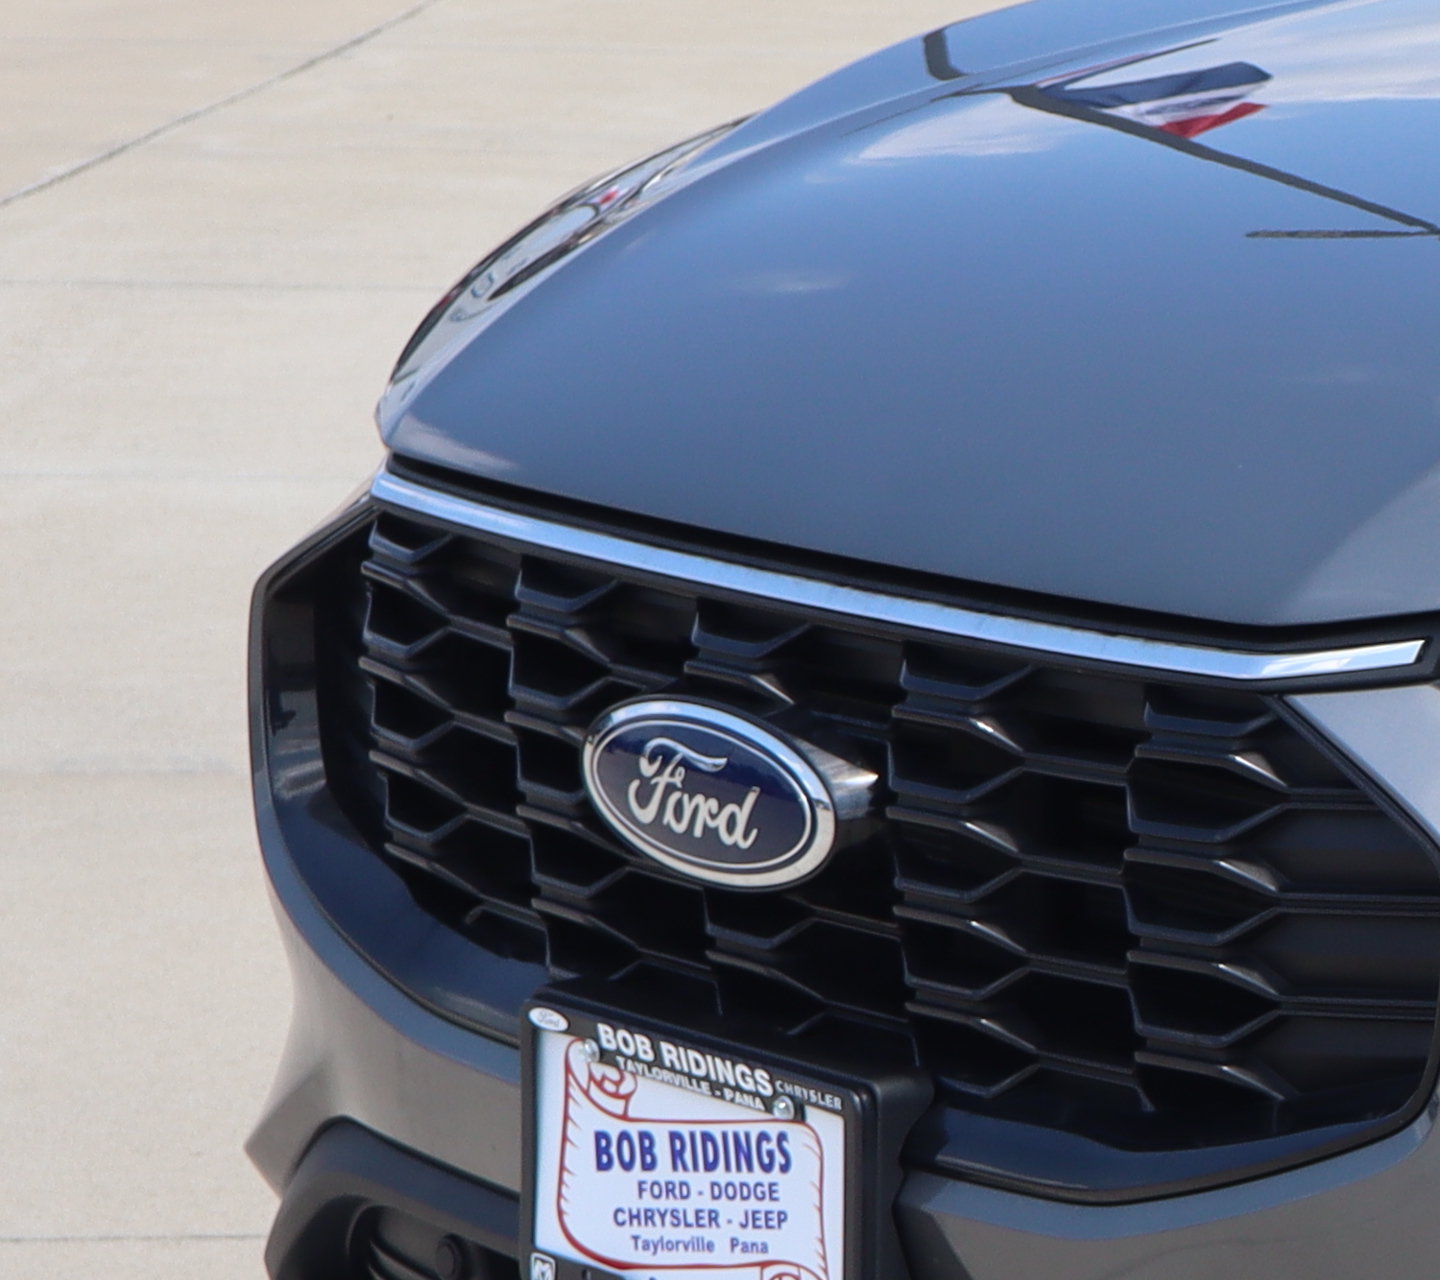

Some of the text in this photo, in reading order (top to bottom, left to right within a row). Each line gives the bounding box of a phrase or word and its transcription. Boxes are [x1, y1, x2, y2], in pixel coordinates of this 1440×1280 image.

[628, 736, 759, 850] Ford
[597, 1022, 774, 1097] BOB RIDINGS
[616, 1055, 711, 1096] TAYLORVILLE
[723, 1088, 766, 1111] PANA
[775, 1079, 842, 1111] CHRYSLER
[594, 1129, 792, 1175] BOB RIDINGS
[637, 1180, 691, 1201] FORD
[710, 1181, 780, 1202] DODGE
[613, 1208, 720, 1230] CHRYSLER
[738, 1209, 789, 1230] JEEP
[630, 1234, 769, 1256] Taylorville Pana
